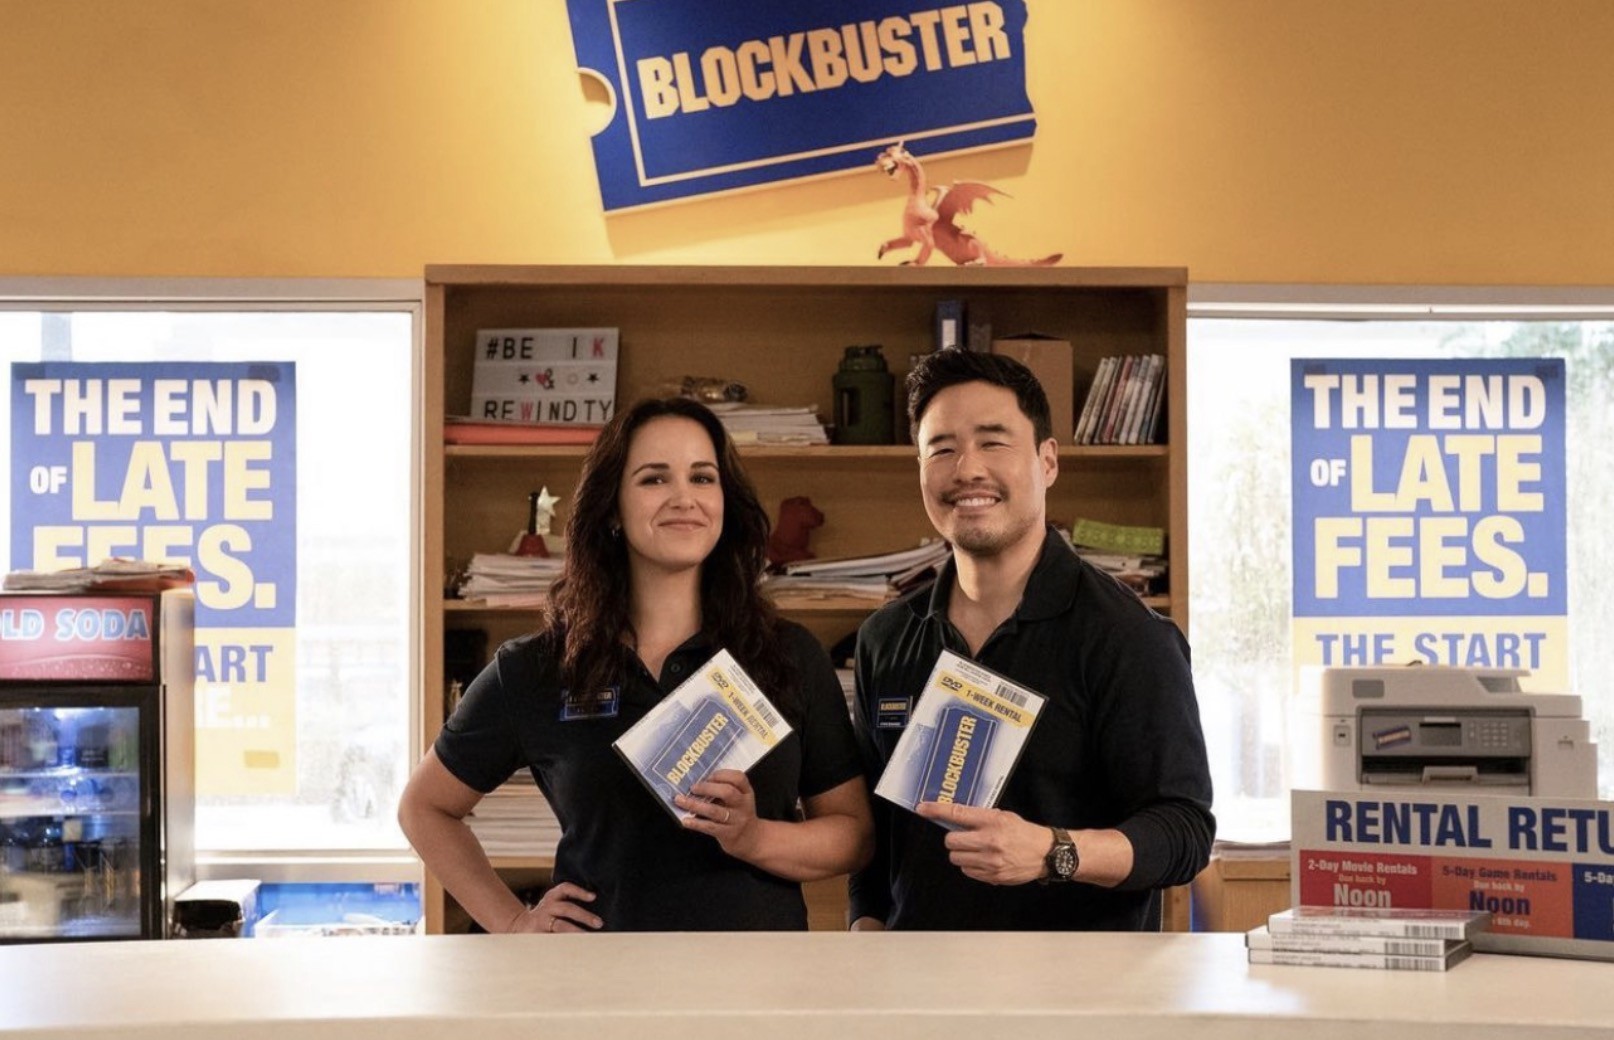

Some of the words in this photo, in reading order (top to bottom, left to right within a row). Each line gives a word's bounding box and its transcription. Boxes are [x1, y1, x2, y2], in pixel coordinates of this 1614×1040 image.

[636, 1, 1011, 119] BLOCKBUSTER
[486, 337, 534, 359] #BE
[25, 379, 142, 435] THE
[153, 379, 277, 435] END
[1304, 374, 1417, 429] THE
[1428, 375, 1546, 429] END
[30, 466, 67, 494] OF
[72, 440, 273, 521] LATE
[1310, 459, 1346, 486] OF
[1351, 434, 1544, 512] LATE
[1314, 515, 1548, 599] FEES.
[0, 609, 44, 640] LD
[55, 608, 150, 641] SODA
[1315, 634, 1394, 665] THE
[1414, 633, 1546, 669] START
[711, 671, 729, 690] DVD
[941, 676, 963, 692] DVD
[966, 689, 994, 709] 1-WEEK
[994, 703, 1023, 723] RENTAL
[666, 712, 729, 786] BLOCKBUSTER
[937, 715, 978, 804] BLOCKBUSTER
[1326, 800, 1492, 848] RENTAL
[1308, 859, 1339, 873] 2-Day
[1342, 860, 1374, 873] Movie
[1376, 862, 1418, 875] Rentals
[1442, 865, 1475, 879] 5-Day
[1479, 867, 1510, 879] Game
[1513, 869, 1557, 882] Rentals
[1333, 883, 1391, 907] Noon
[1469, 890, 1530, 916] Noon
